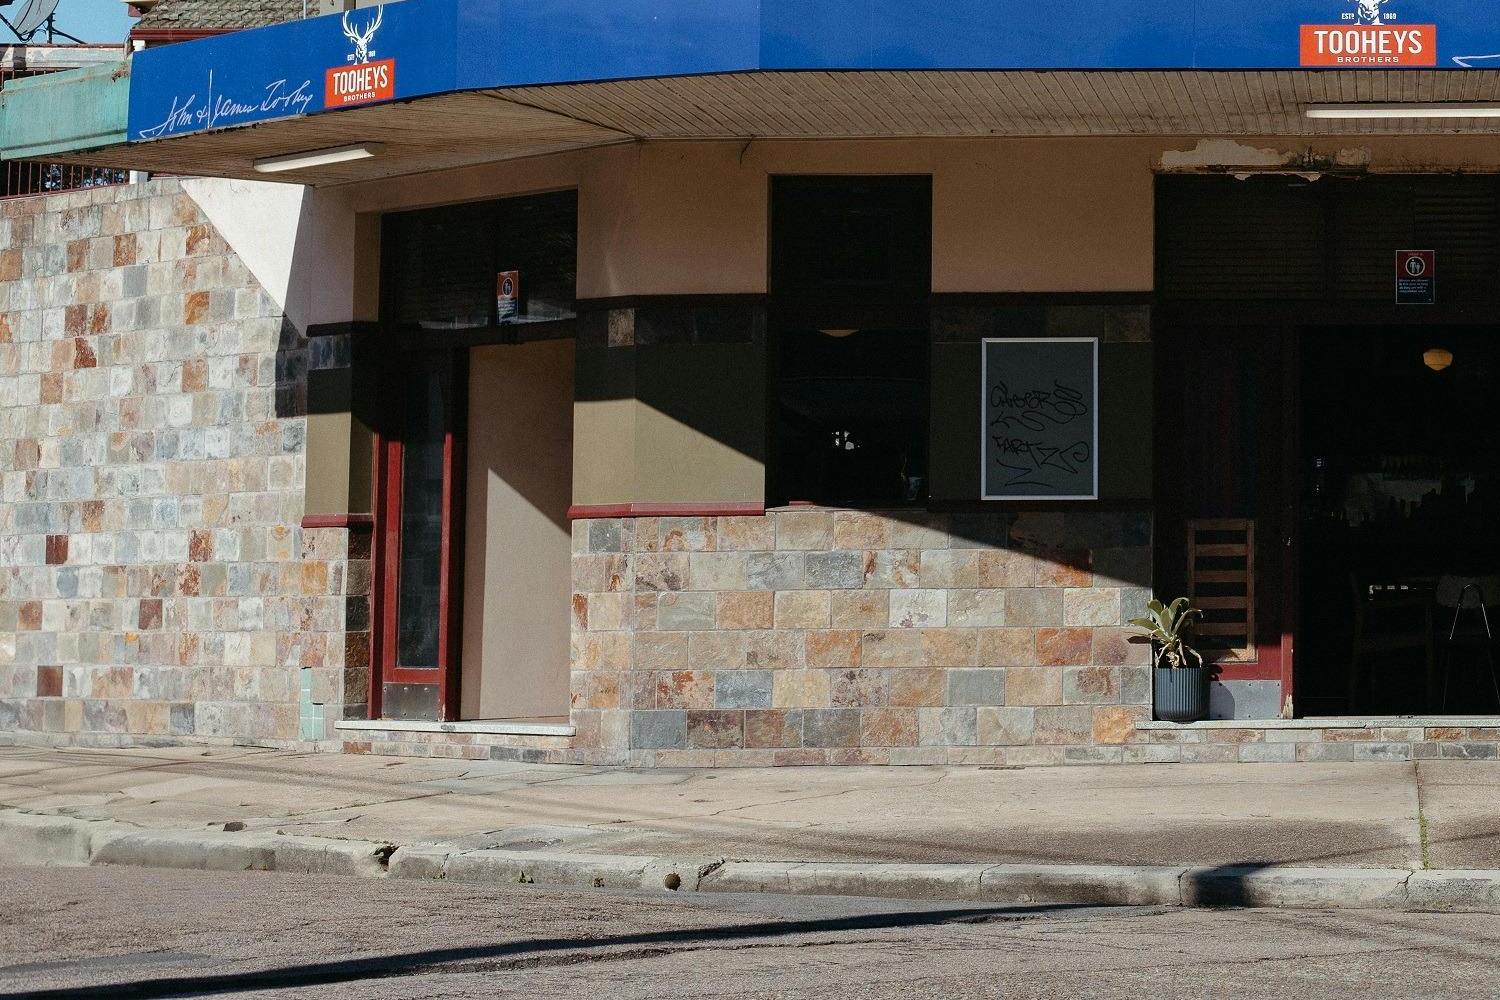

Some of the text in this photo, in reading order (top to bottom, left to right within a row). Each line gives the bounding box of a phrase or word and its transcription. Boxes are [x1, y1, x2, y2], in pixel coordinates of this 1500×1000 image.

[1313, 30, 1423, 54] TOOHEYS
[1337, 55, 1400, 63] BROTHERS
[332, 64, 388, 96] TOOHEYS
[343, 91, 376, 102] BROTHERS
[139, 94, 196, 139] John
[196, 104, 208, 123] &
[209, 94, 259, 129] James
